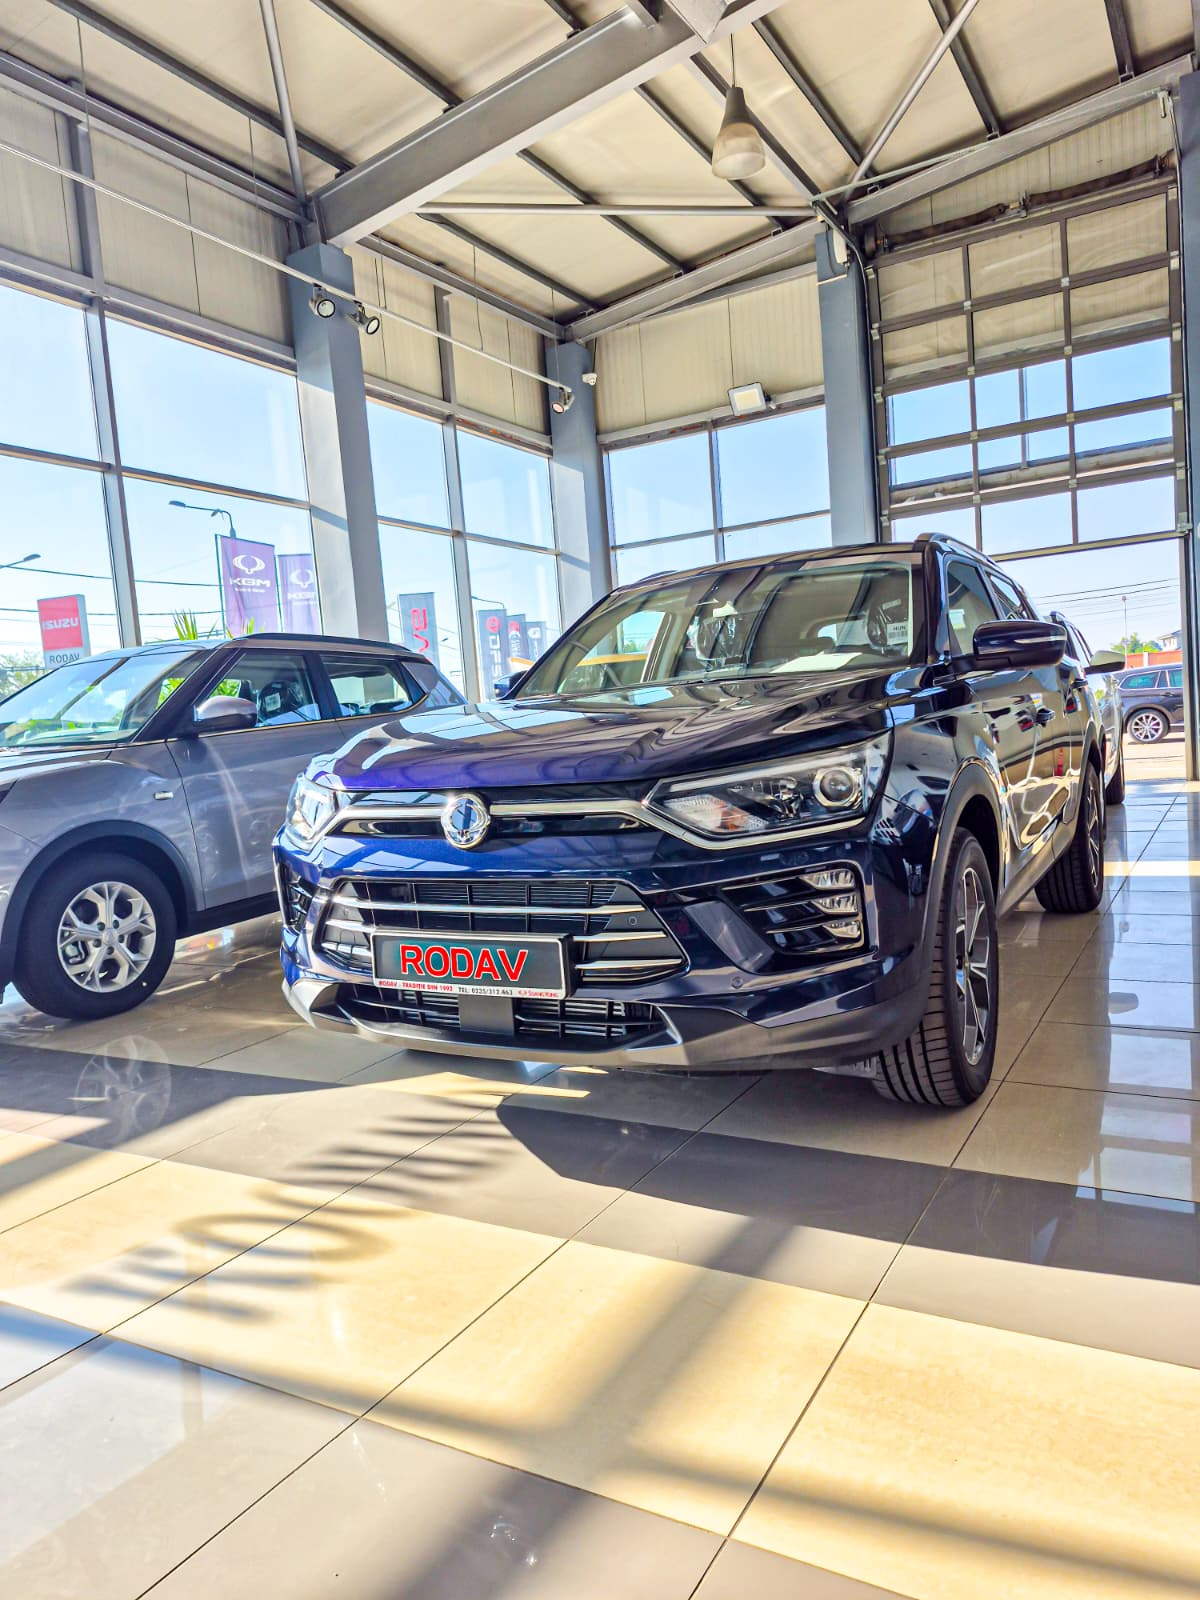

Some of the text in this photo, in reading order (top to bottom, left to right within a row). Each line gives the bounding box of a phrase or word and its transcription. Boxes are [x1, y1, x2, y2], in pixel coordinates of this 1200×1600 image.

[229, 577, 271, 588] KGM
[43, 617, 78, 629] ISUZU
[49, 653, 80, 664] RODAV
[400, 943, 529, 982] RODAV
